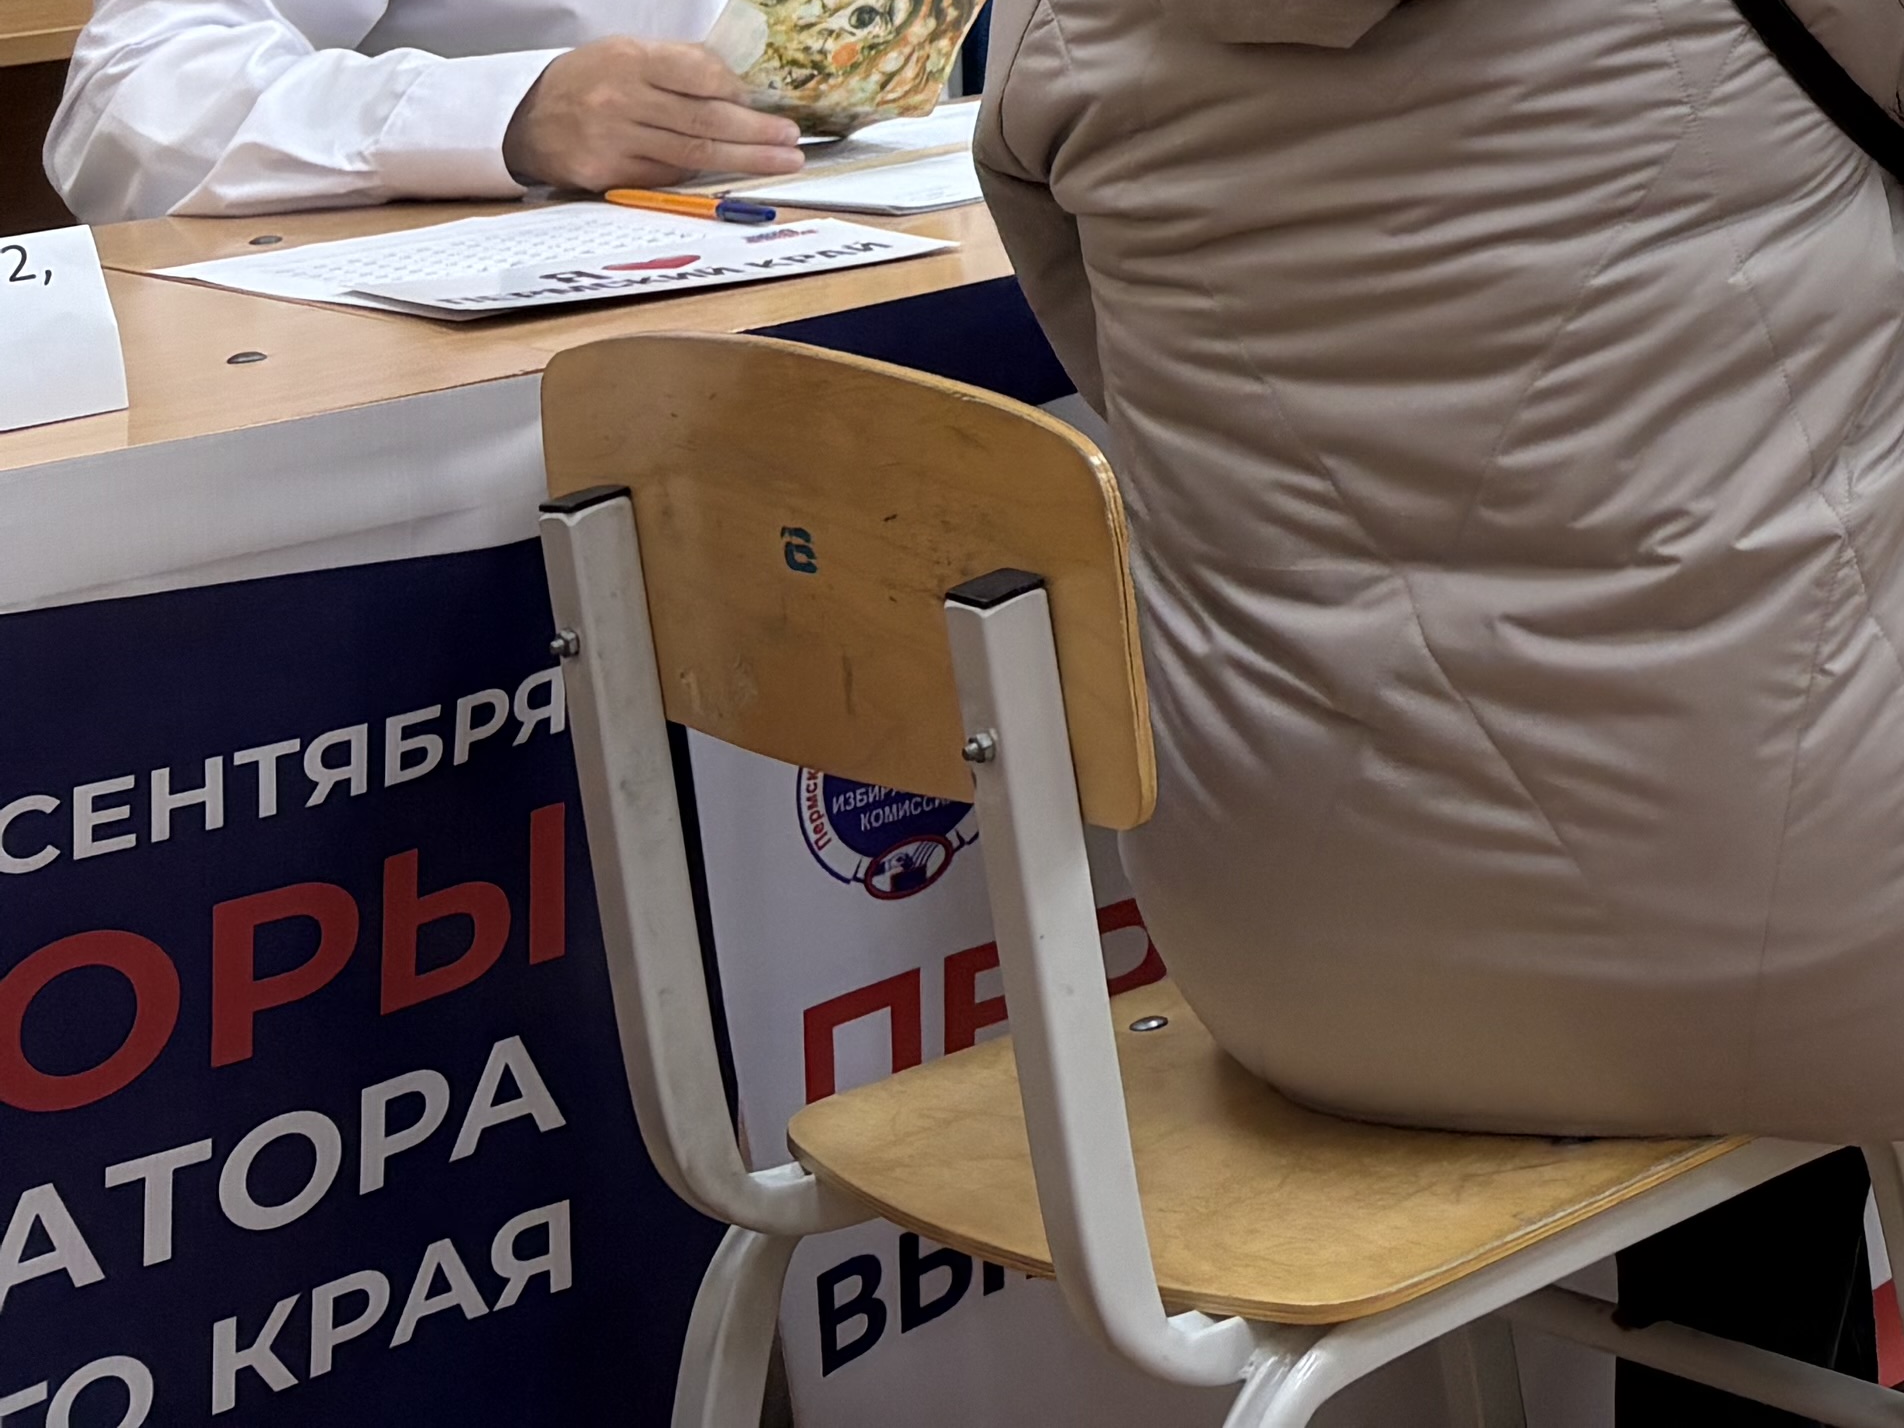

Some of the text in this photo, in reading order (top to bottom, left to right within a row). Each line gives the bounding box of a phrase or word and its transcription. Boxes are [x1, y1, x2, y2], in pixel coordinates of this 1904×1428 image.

[744, 241, 893, 269] КРАЙ
[0, 665, 566, 874] СЕНТЯБРЯ
[0, 802, 566, 1112] ОРЫ
[0, 1035, 567, 1313] АТОРА
[212, 1199, 572, 1416] КРАЯ
